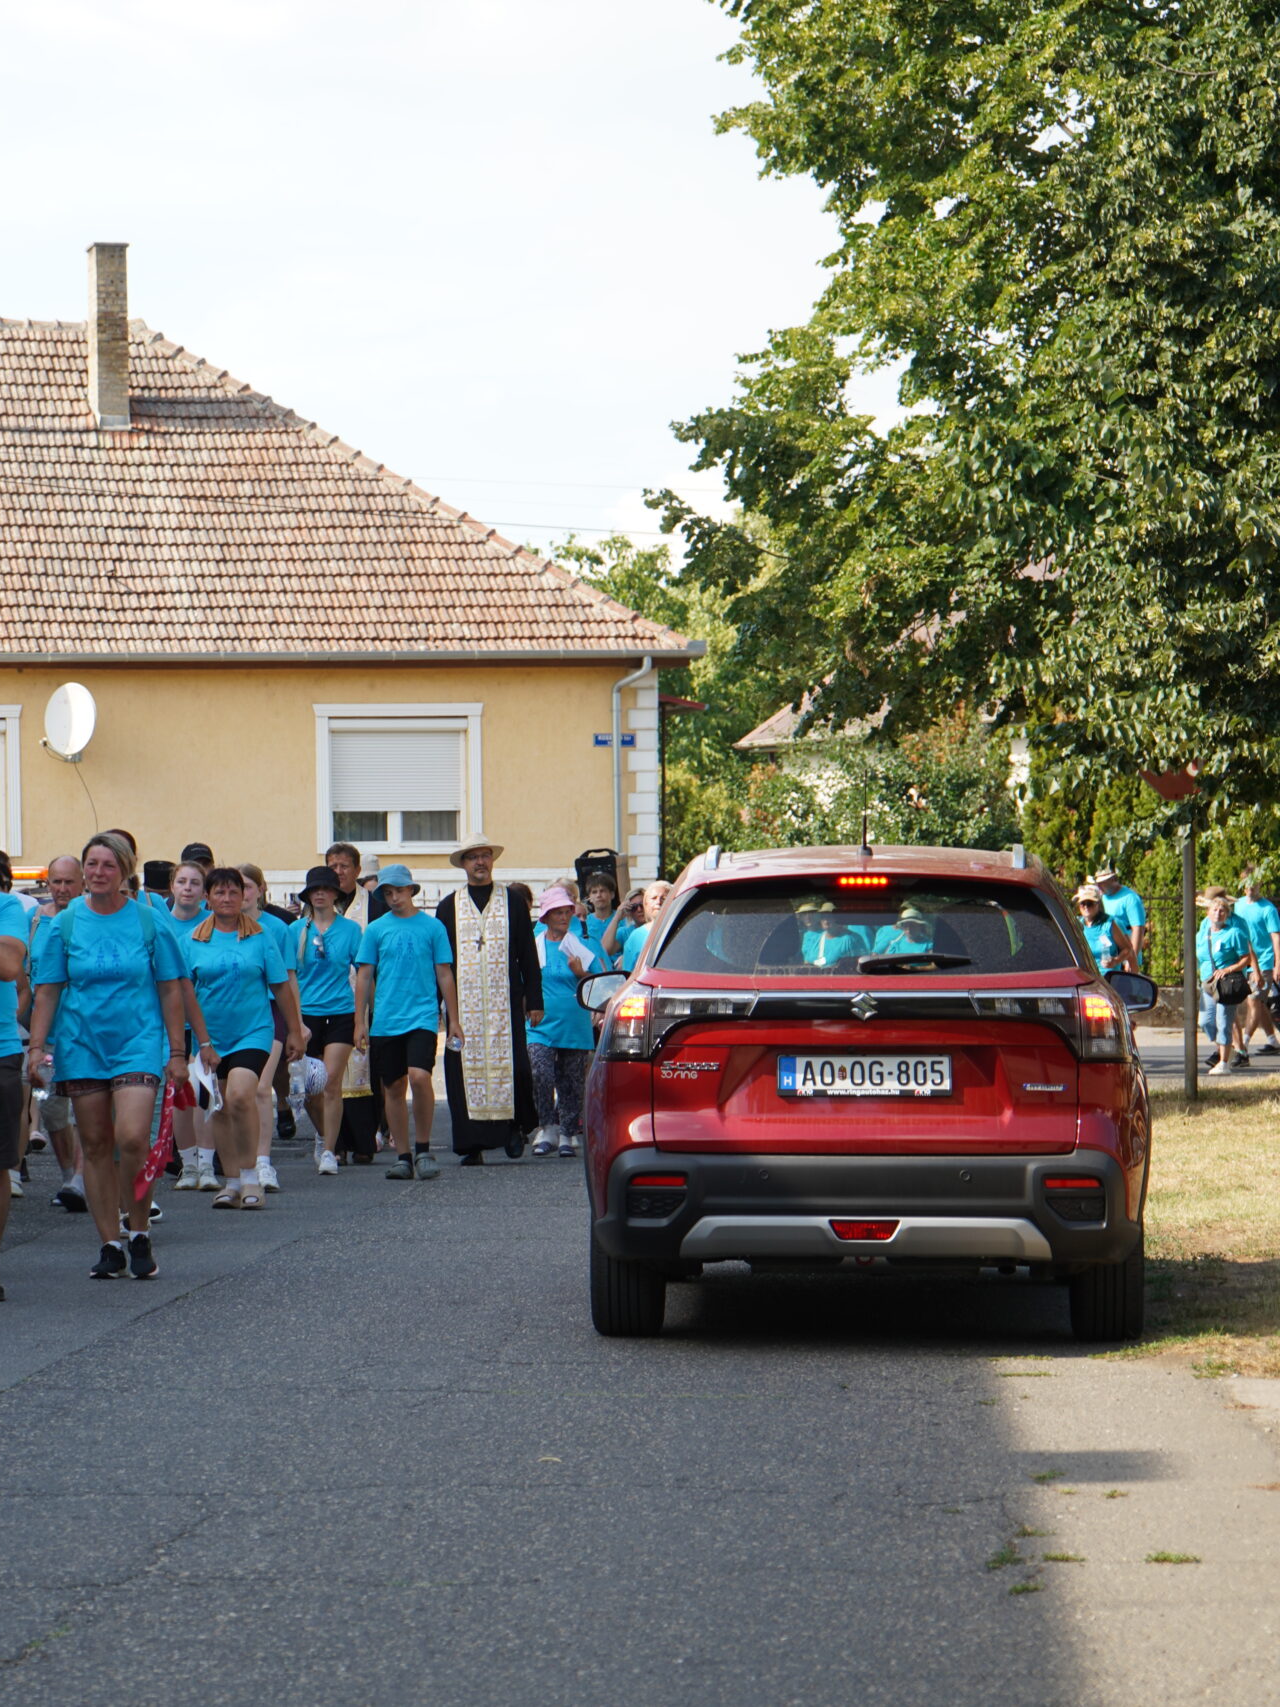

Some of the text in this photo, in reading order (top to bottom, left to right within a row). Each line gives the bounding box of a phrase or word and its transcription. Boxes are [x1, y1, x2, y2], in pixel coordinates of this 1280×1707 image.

[783, 1075, 793, 1087] H
[802, 1060, 945, 1087] AO OG-805
